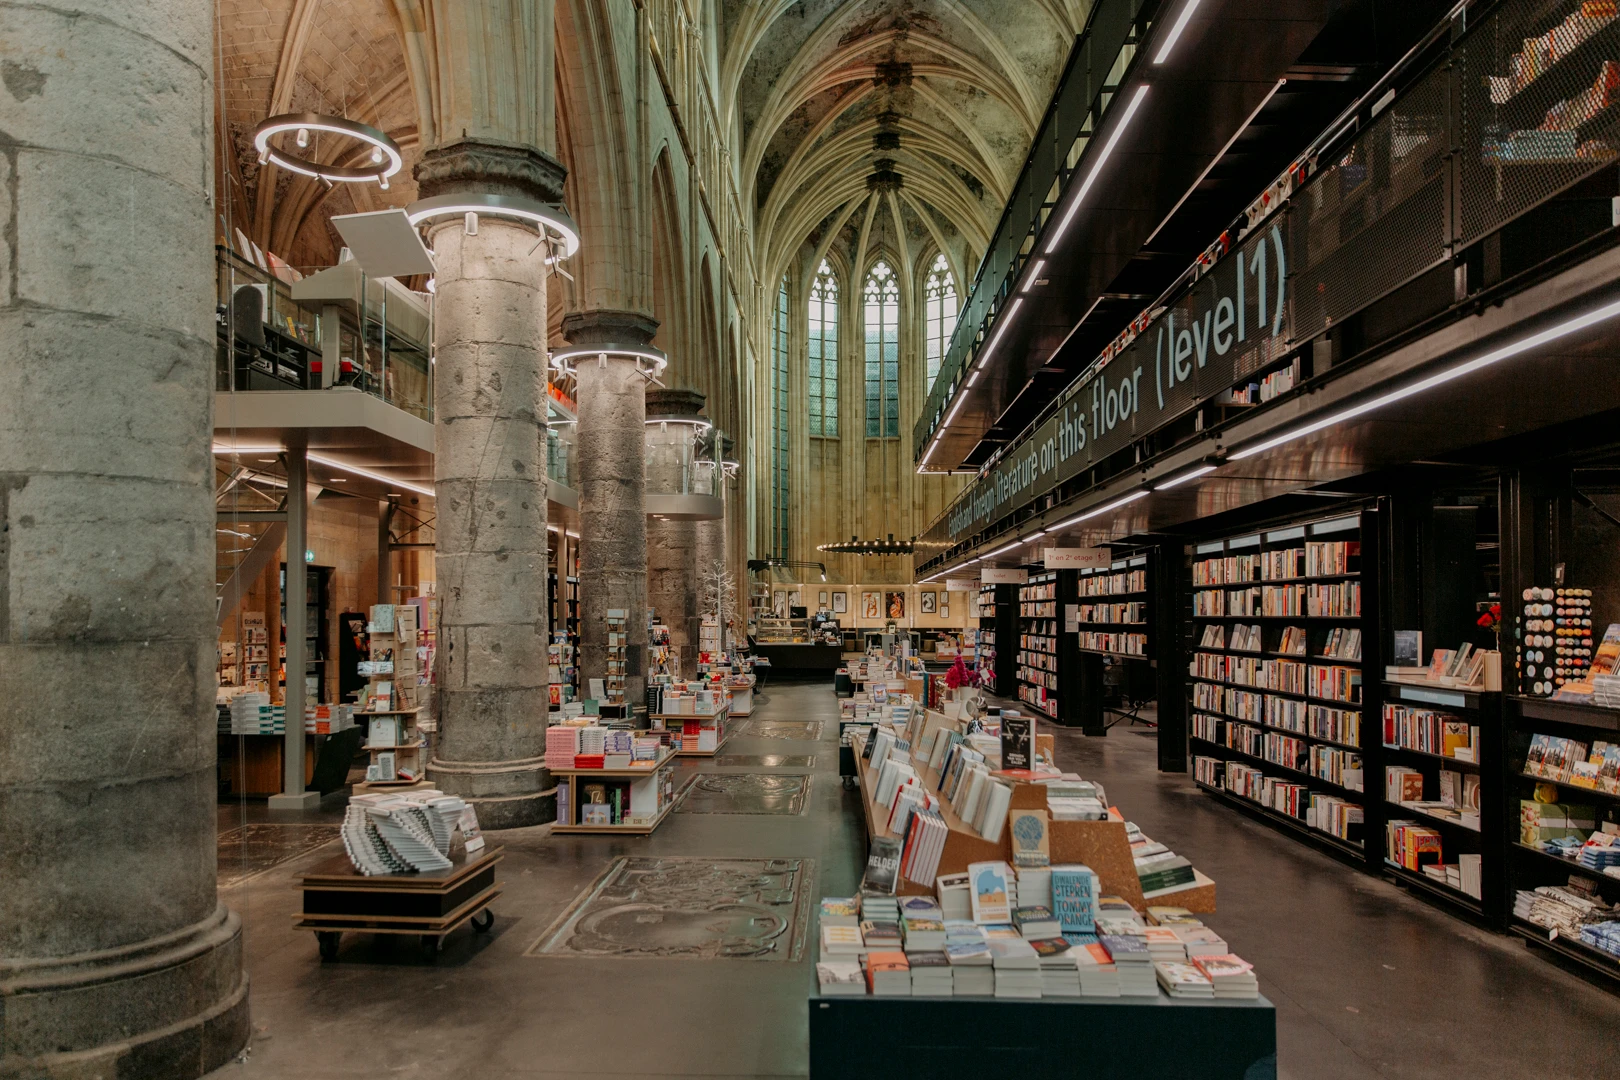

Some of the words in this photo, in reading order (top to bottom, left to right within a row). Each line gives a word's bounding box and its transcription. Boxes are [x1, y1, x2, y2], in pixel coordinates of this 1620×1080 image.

[948, 503, 963, 543] English
[963, 493, 973, 529] and
[973, 483, 995, 524] foreign
[996, 451, 1038, 506] literature
[1040, 437, 1056, 475] on
[1059, 402, 1087, 463] this
[1092, 366, 1142, 440] floor
[1073, 555, 1093, 563] etage
[868, 854, 897, 870] HELDER
[1054, 875, 1089, 885] DWALENDE
[1056, 900, 1092, 913] TOMMY
[1057, 912, 1093, 926] ORANGE
